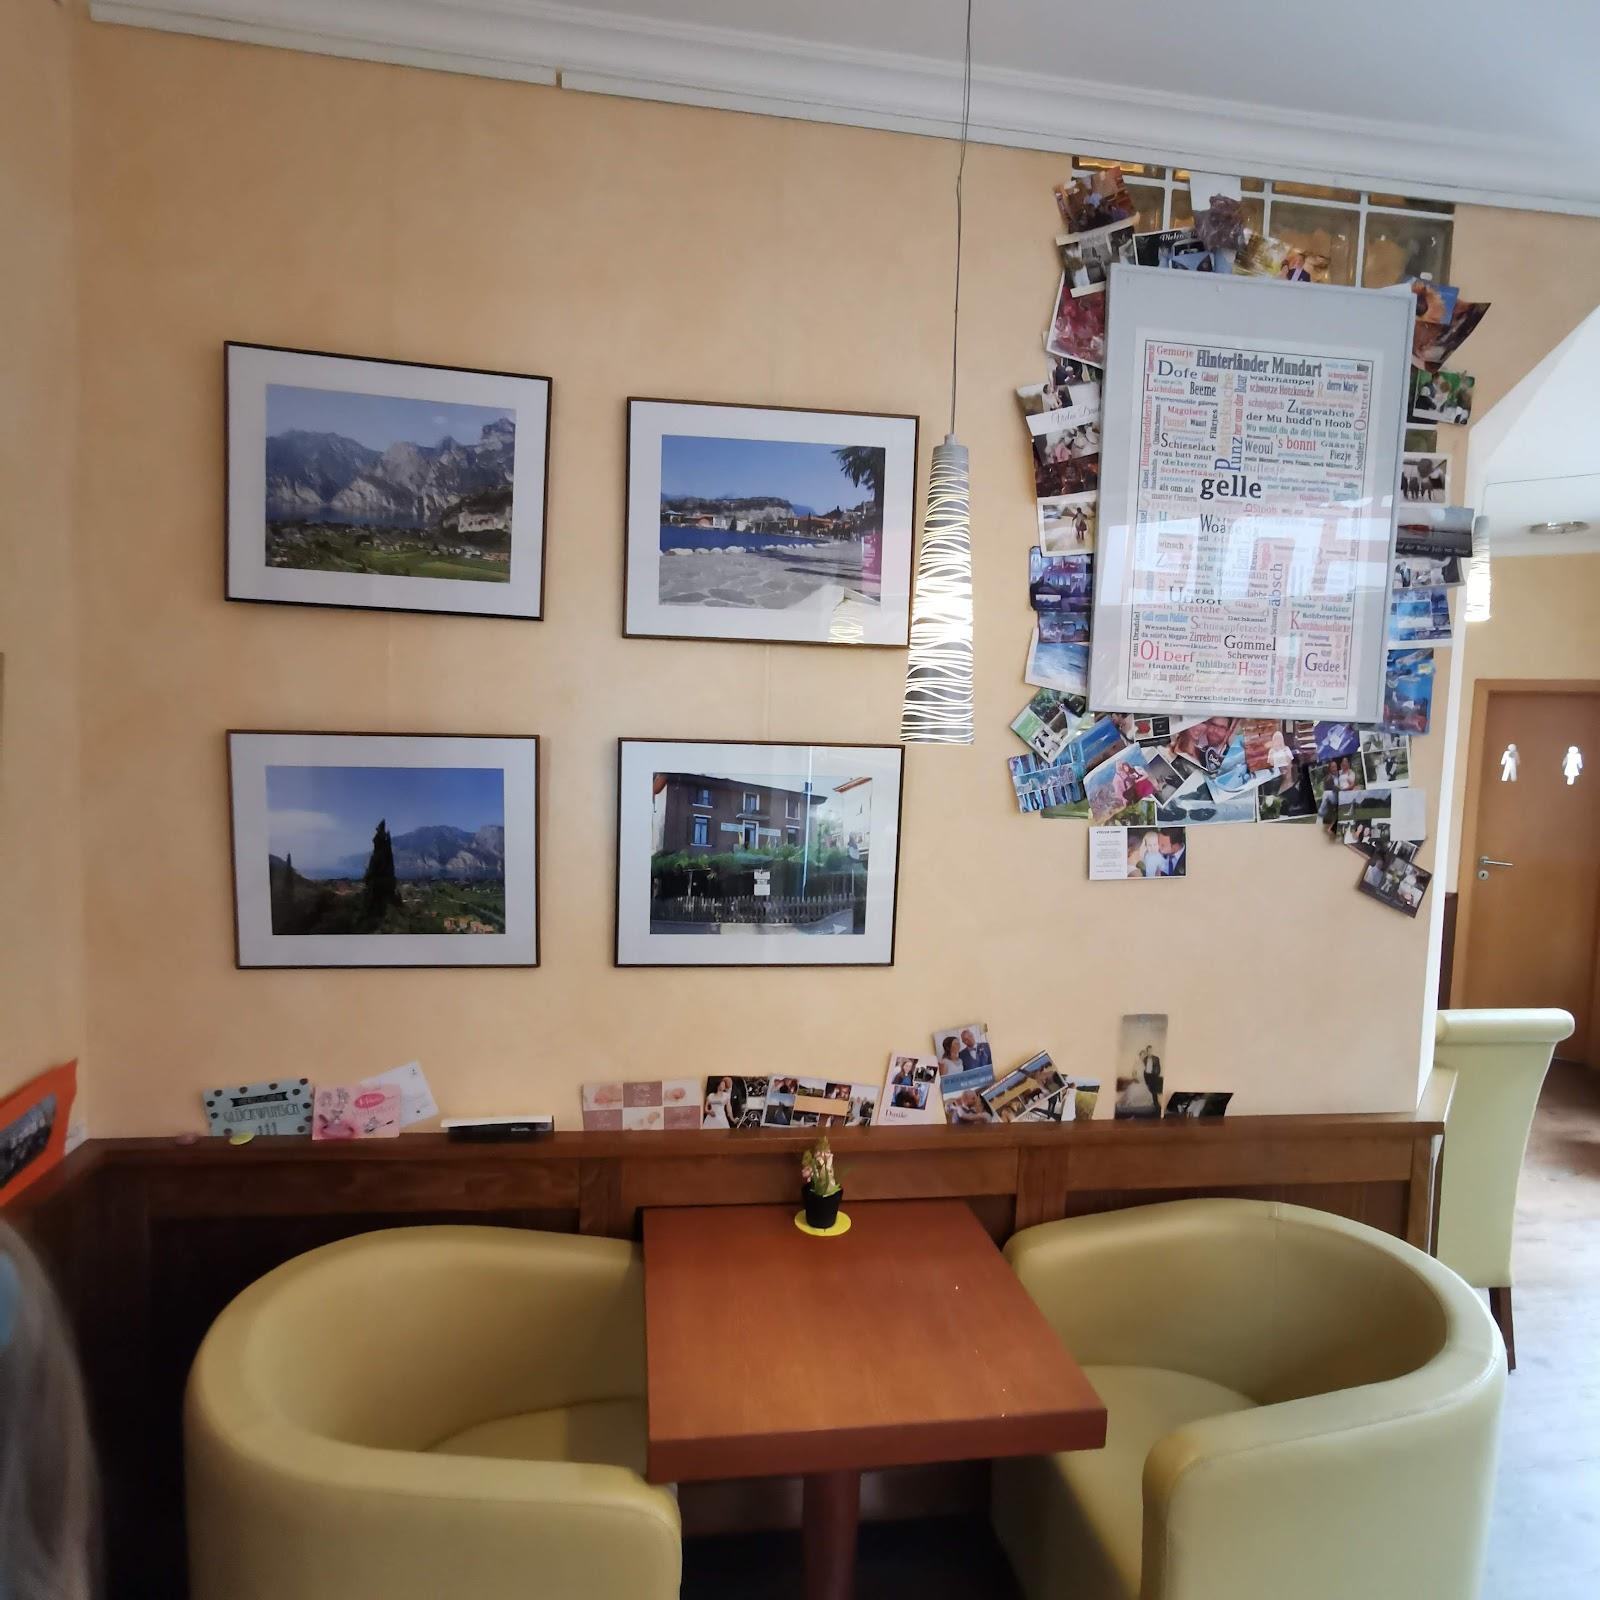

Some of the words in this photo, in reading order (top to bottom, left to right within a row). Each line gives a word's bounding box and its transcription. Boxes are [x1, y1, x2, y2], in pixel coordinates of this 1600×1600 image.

[1196, 349, 1269, 373] Hinterländer
[1272, 356, 1322, 378] Mundart
[1199, 474, 1262, 500] gelle
